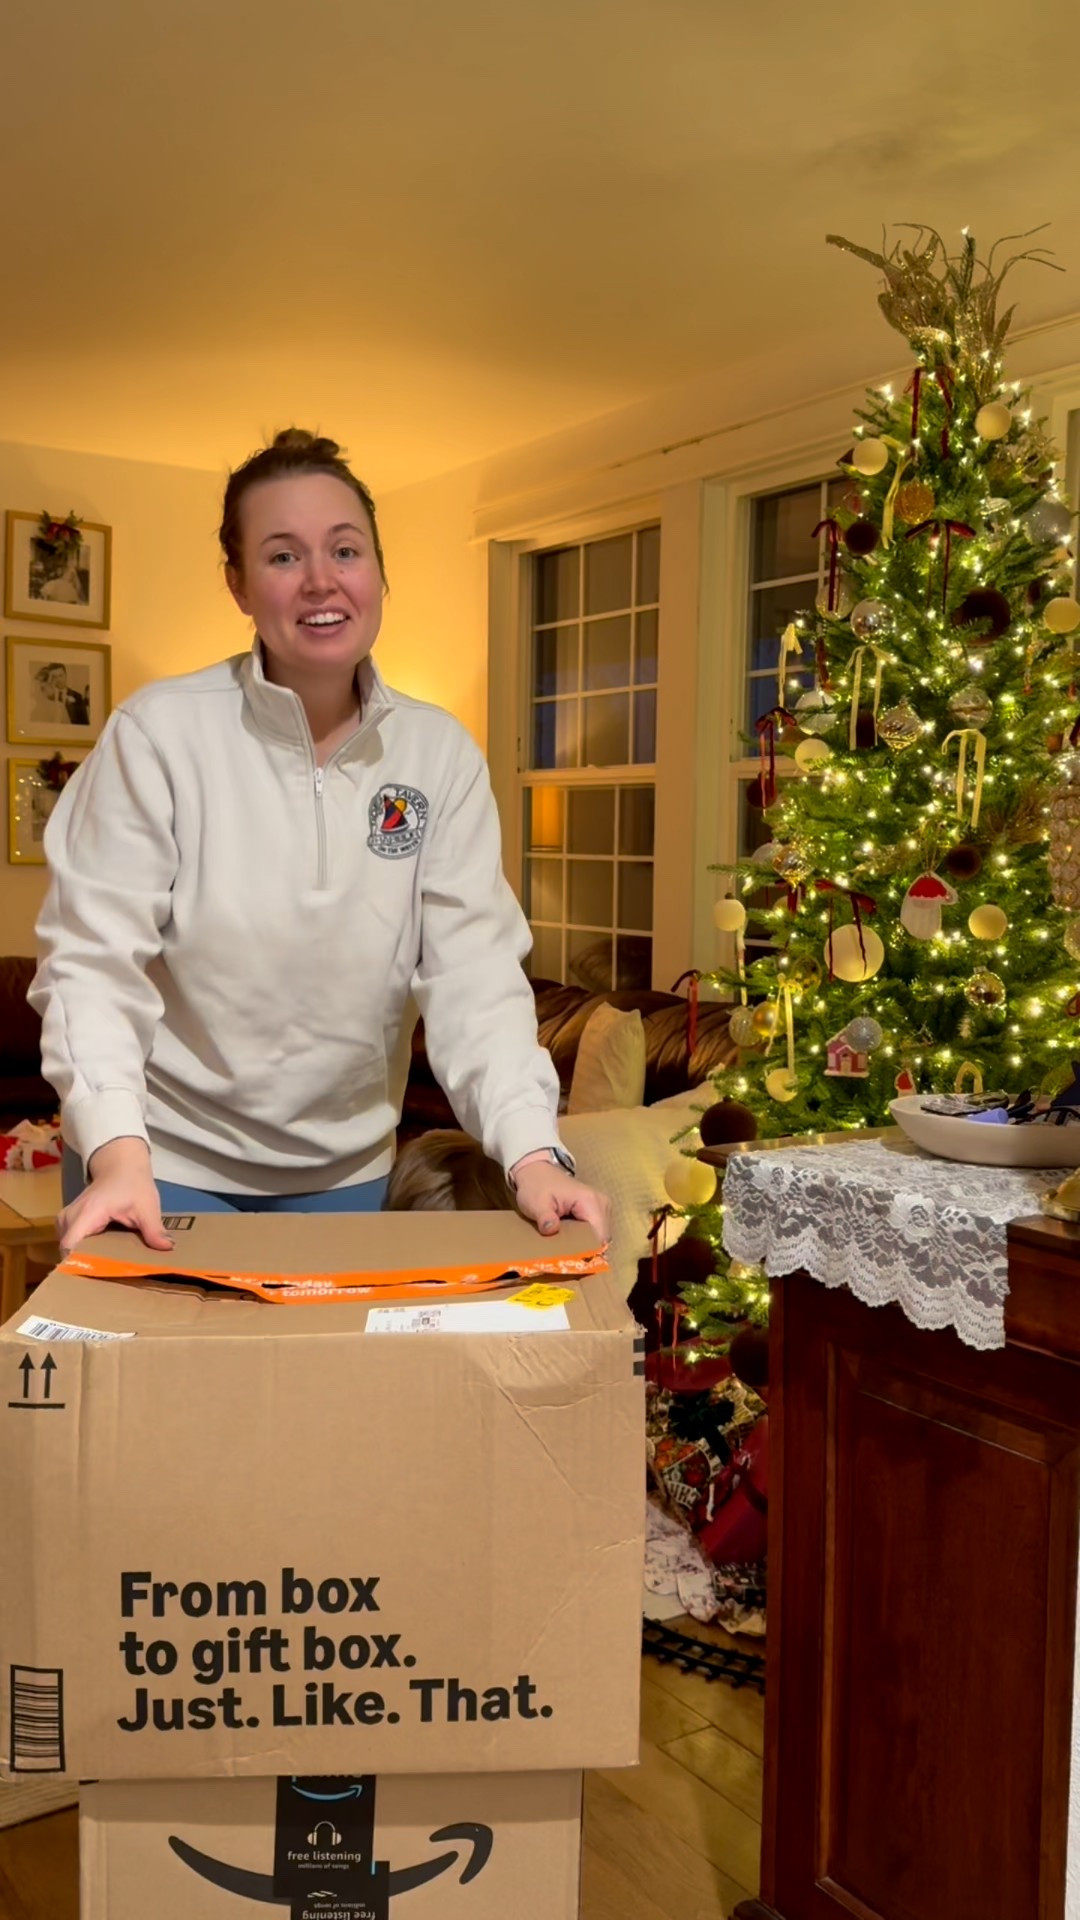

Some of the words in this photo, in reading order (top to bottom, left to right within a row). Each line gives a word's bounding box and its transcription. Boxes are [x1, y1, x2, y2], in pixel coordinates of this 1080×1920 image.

[395, 788, 427, 821] TAVERN
[121, 1571, 266, 1618] From
[282, 1568, 380, 1614] box
[120, 1632, 177, 1676] to
[192, 1627, 290, 1685] gift
[304, 1626, 417, 1671] box.
[117, 1687, 260, 1732] Just.
[273, 1682, 400, 1727] Like.
[410, 1675, 553, 1723] That.
[287, 1851, 310, 1861] free
[312, 1851, 362, 1863] listening
[302, 1909, 351, 1920] listening
[353, 1911, 376, 1920] free
